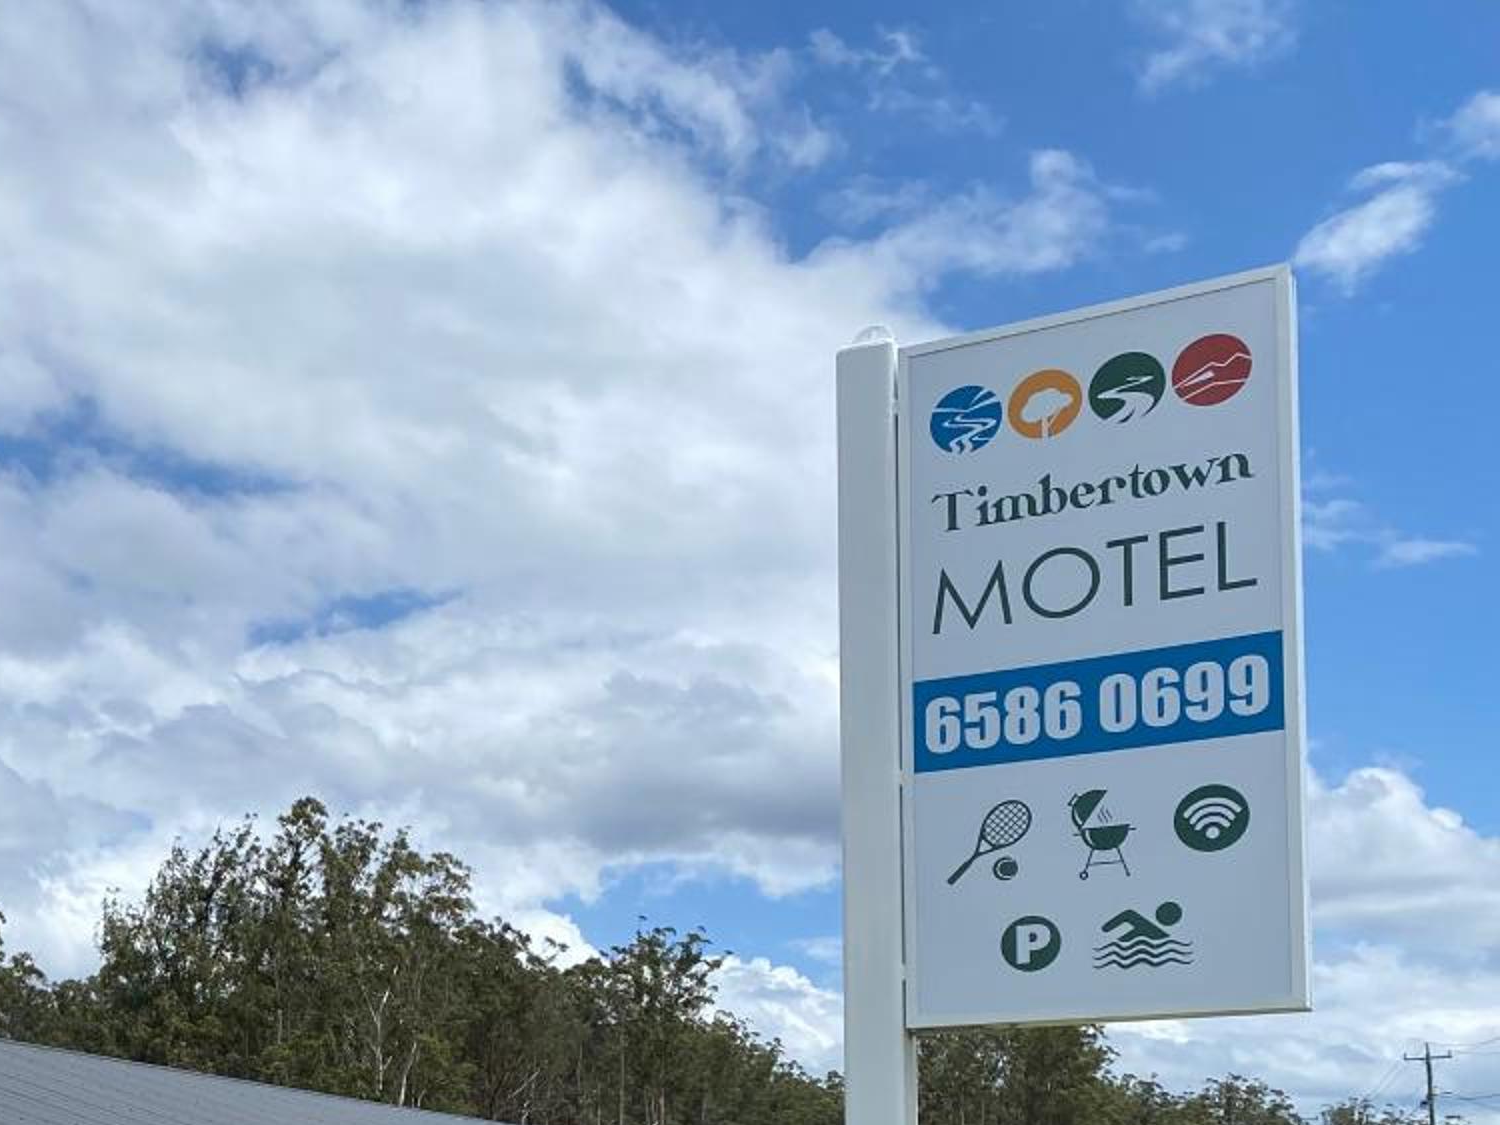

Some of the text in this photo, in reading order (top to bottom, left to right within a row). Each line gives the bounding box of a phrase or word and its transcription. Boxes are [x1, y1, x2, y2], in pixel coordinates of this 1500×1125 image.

[931, 453, 1255, 533] Timbertown
[932, 521, 1258, 634] MOTEL
[924, 654, 1269, 754] 6586 0699
